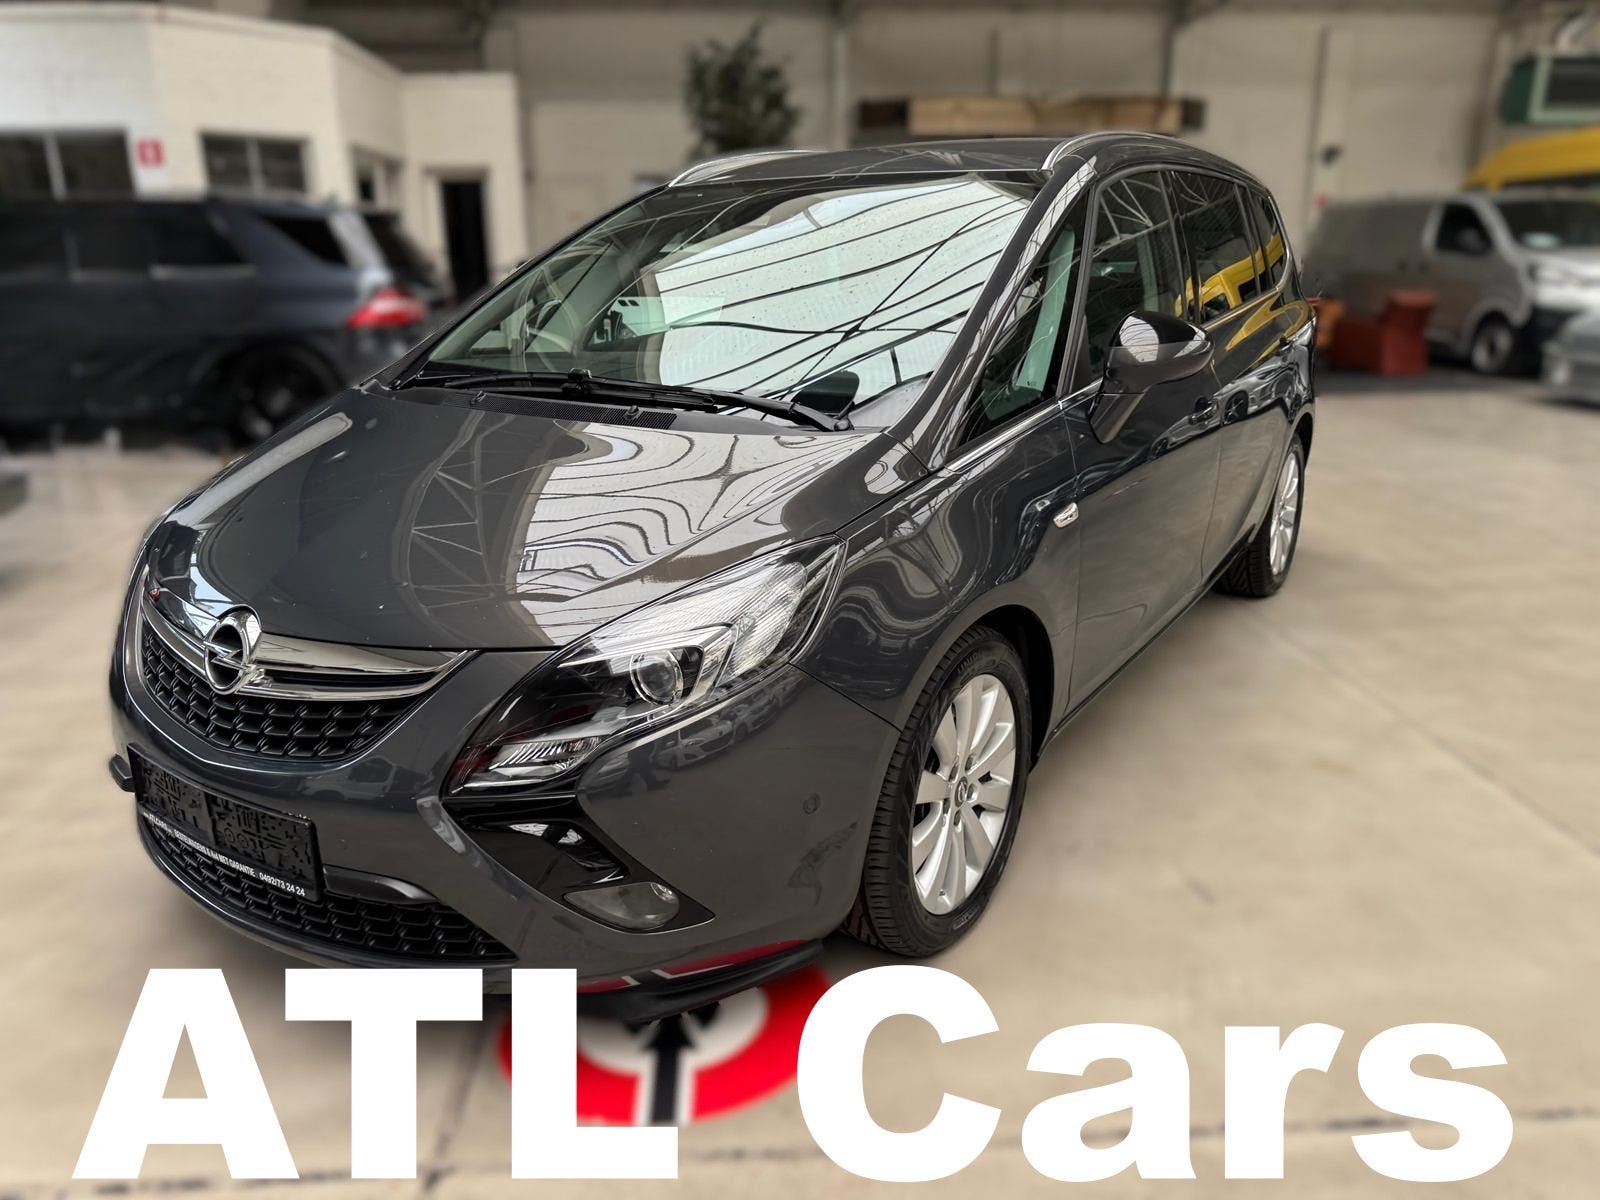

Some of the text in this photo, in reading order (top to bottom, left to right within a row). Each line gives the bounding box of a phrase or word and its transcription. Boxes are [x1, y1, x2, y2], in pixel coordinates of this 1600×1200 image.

[229, 859, 256, 877] GARANTIE
[259, 872, 286, 889] 0492/73
[286, 882, 296, 893] 24
[296, 886, 306, 897] 24
